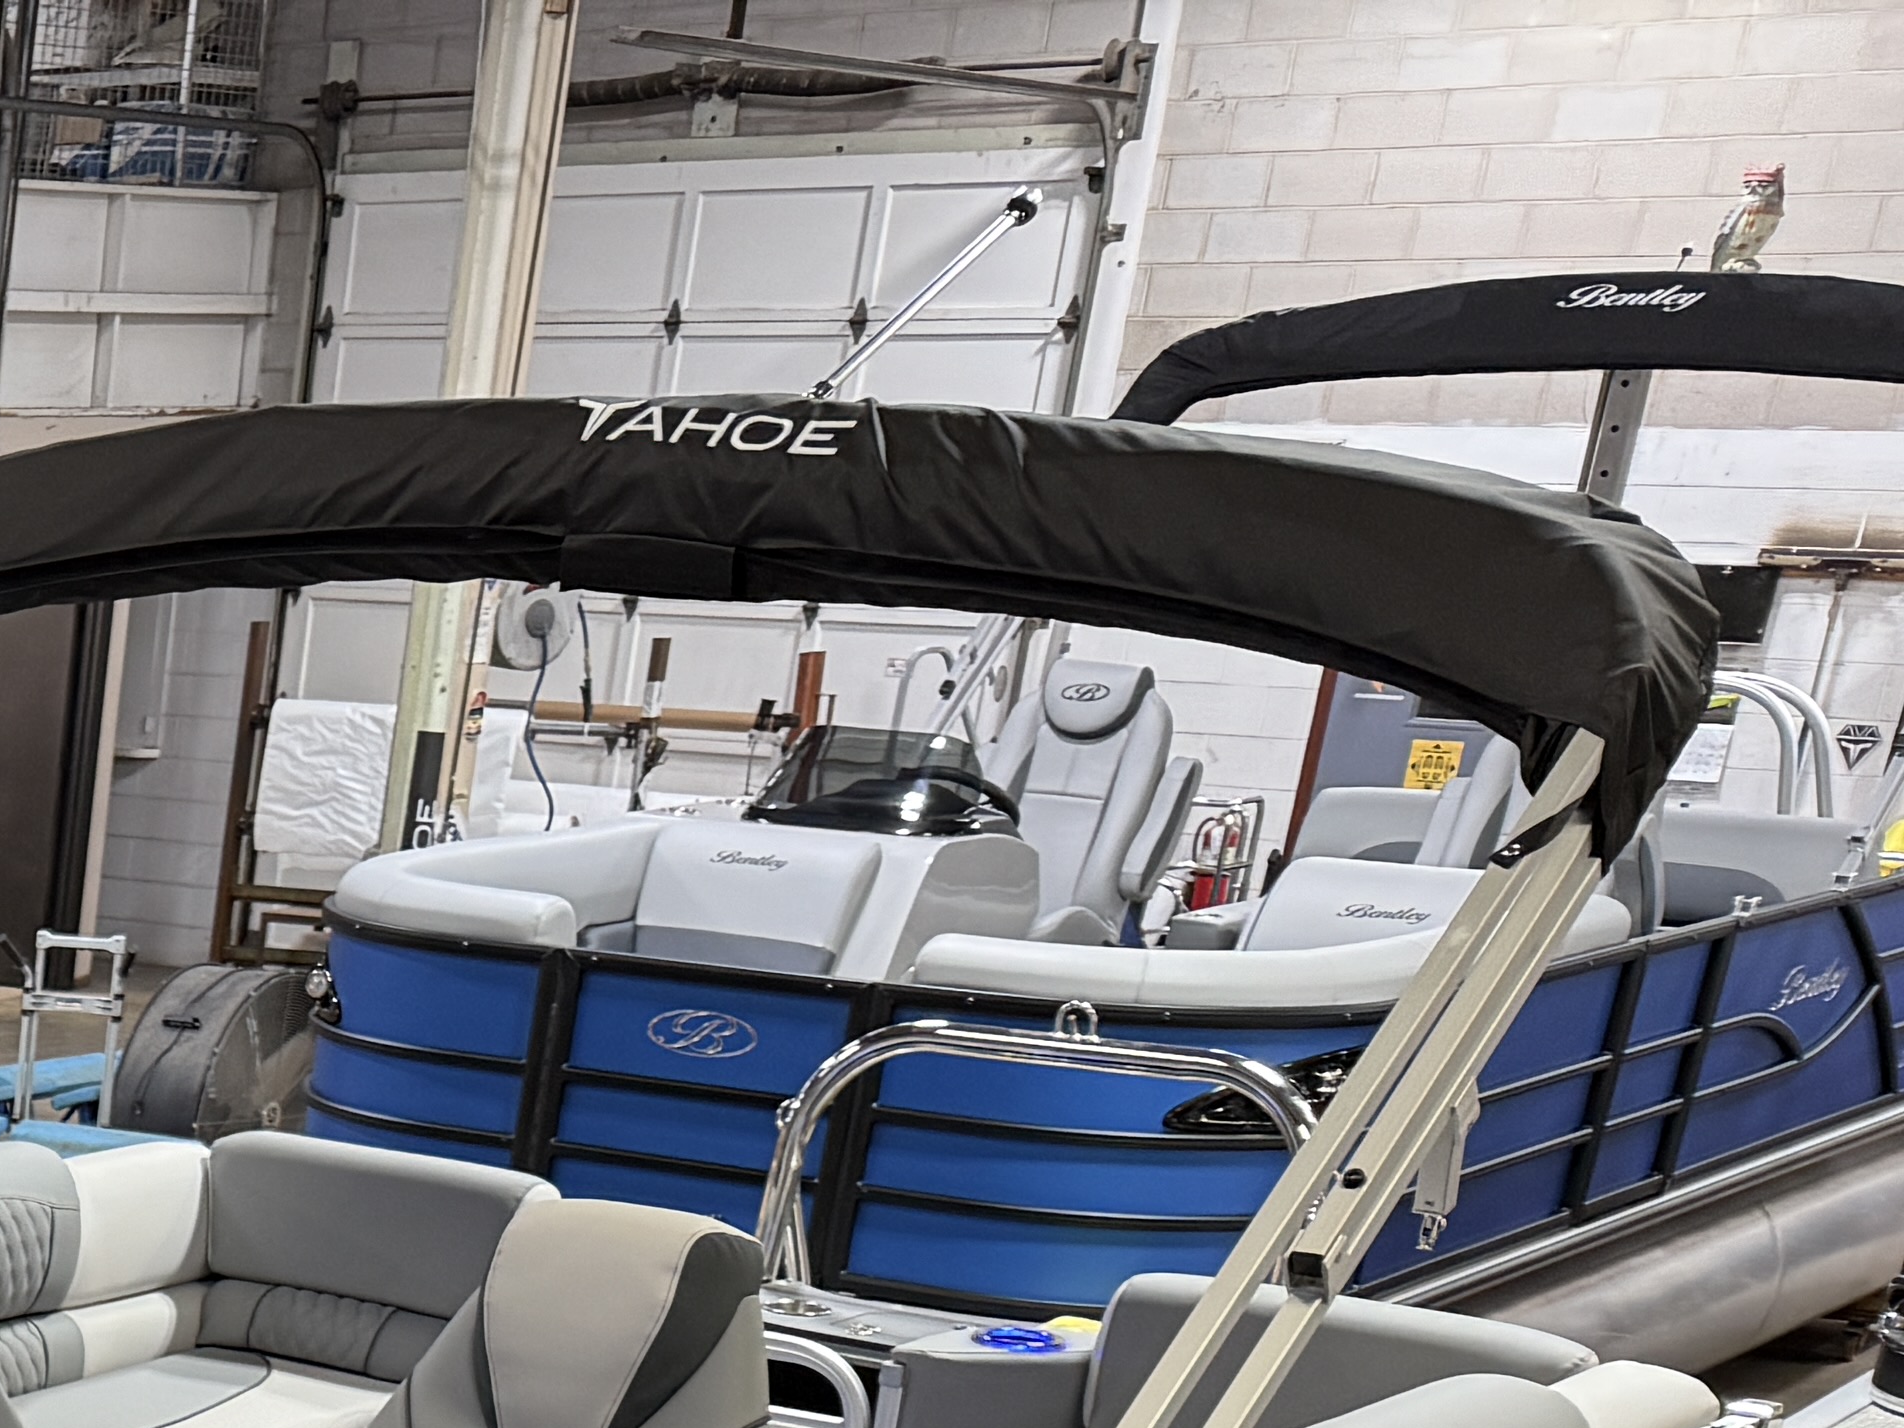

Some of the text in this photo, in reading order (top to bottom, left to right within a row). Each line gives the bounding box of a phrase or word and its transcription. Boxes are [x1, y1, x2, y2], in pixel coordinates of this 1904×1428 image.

[1556, 283, 1707, 313] Bentley
[579, 398, 858, 456] TAHOE
[709, 850, 789, 872] Bentley
[1336, 903, 1431, 925] Bentley
